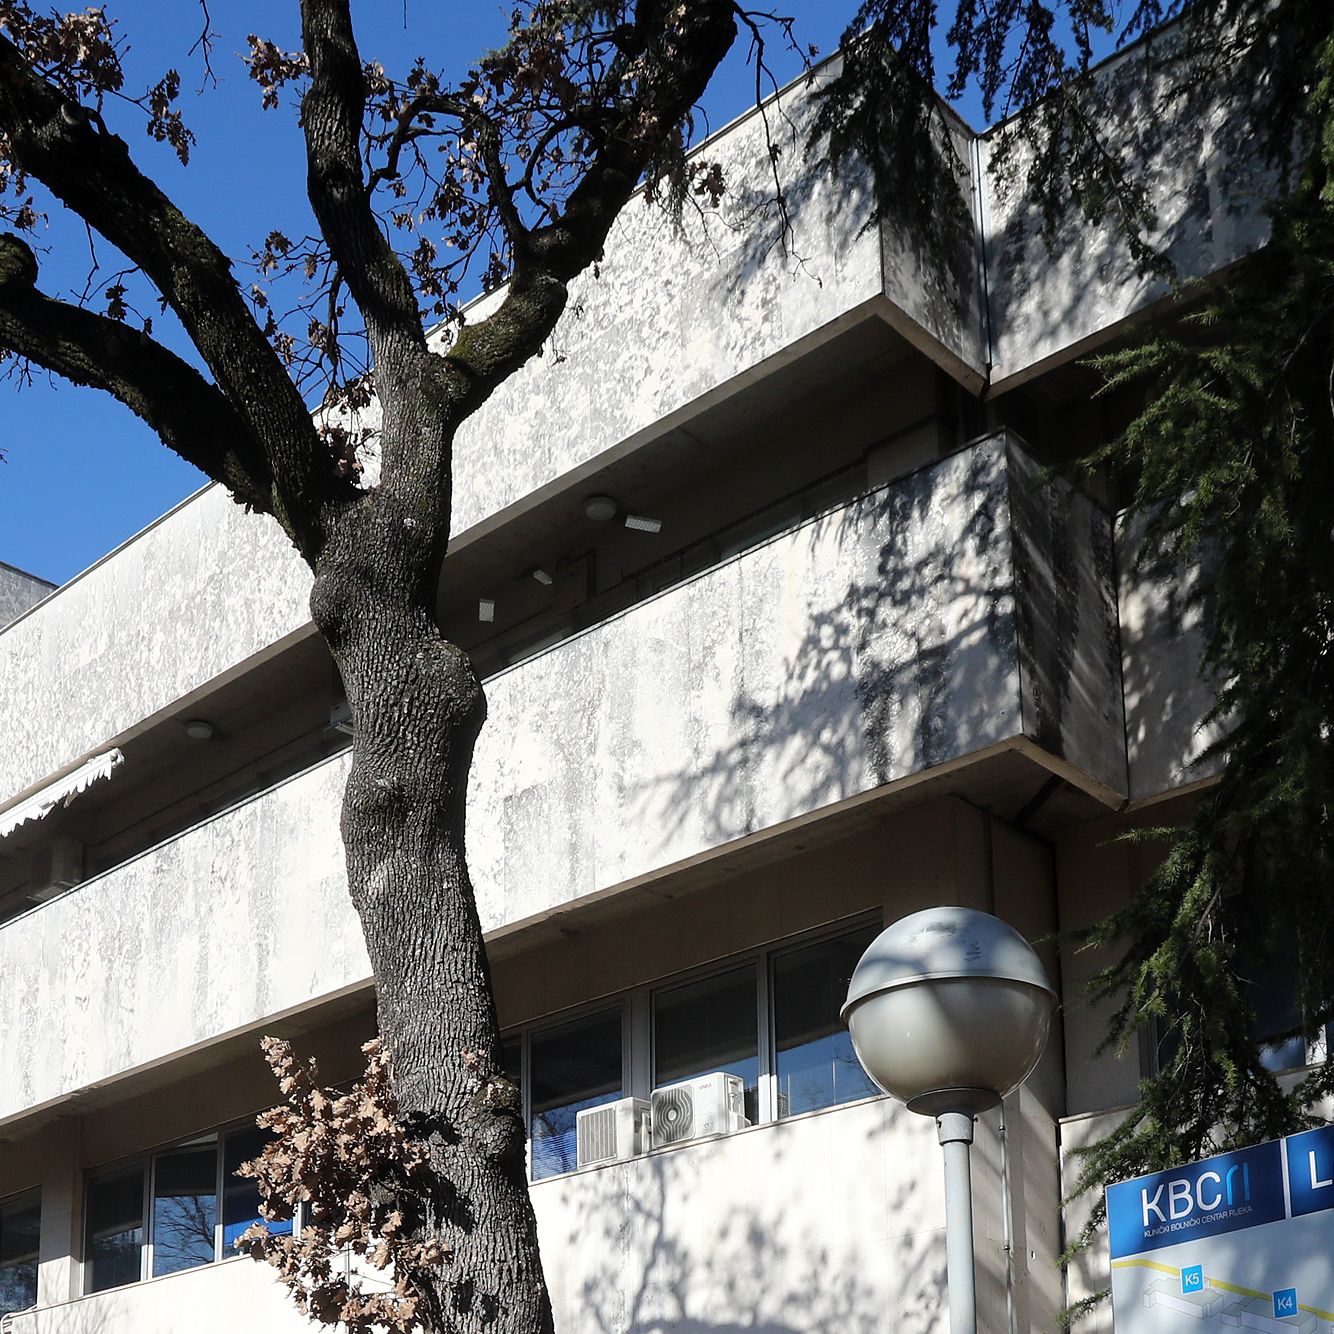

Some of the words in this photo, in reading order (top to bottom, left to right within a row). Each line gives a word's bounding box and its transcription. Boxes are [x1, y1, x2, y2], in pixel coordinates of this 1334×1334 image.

[1145, 1226, 1170, 1238] KLINIČKI
[1171, 1218, 1201, 1231] BOLNIČKI
[1202, 1211, 1227, 1223] CENTAR
[1229, 1206, 1252, 1217] RIJEKA
[1185, 1273, 1200, 1285] K5
[1278, 1297, 1293, 1310] K4
